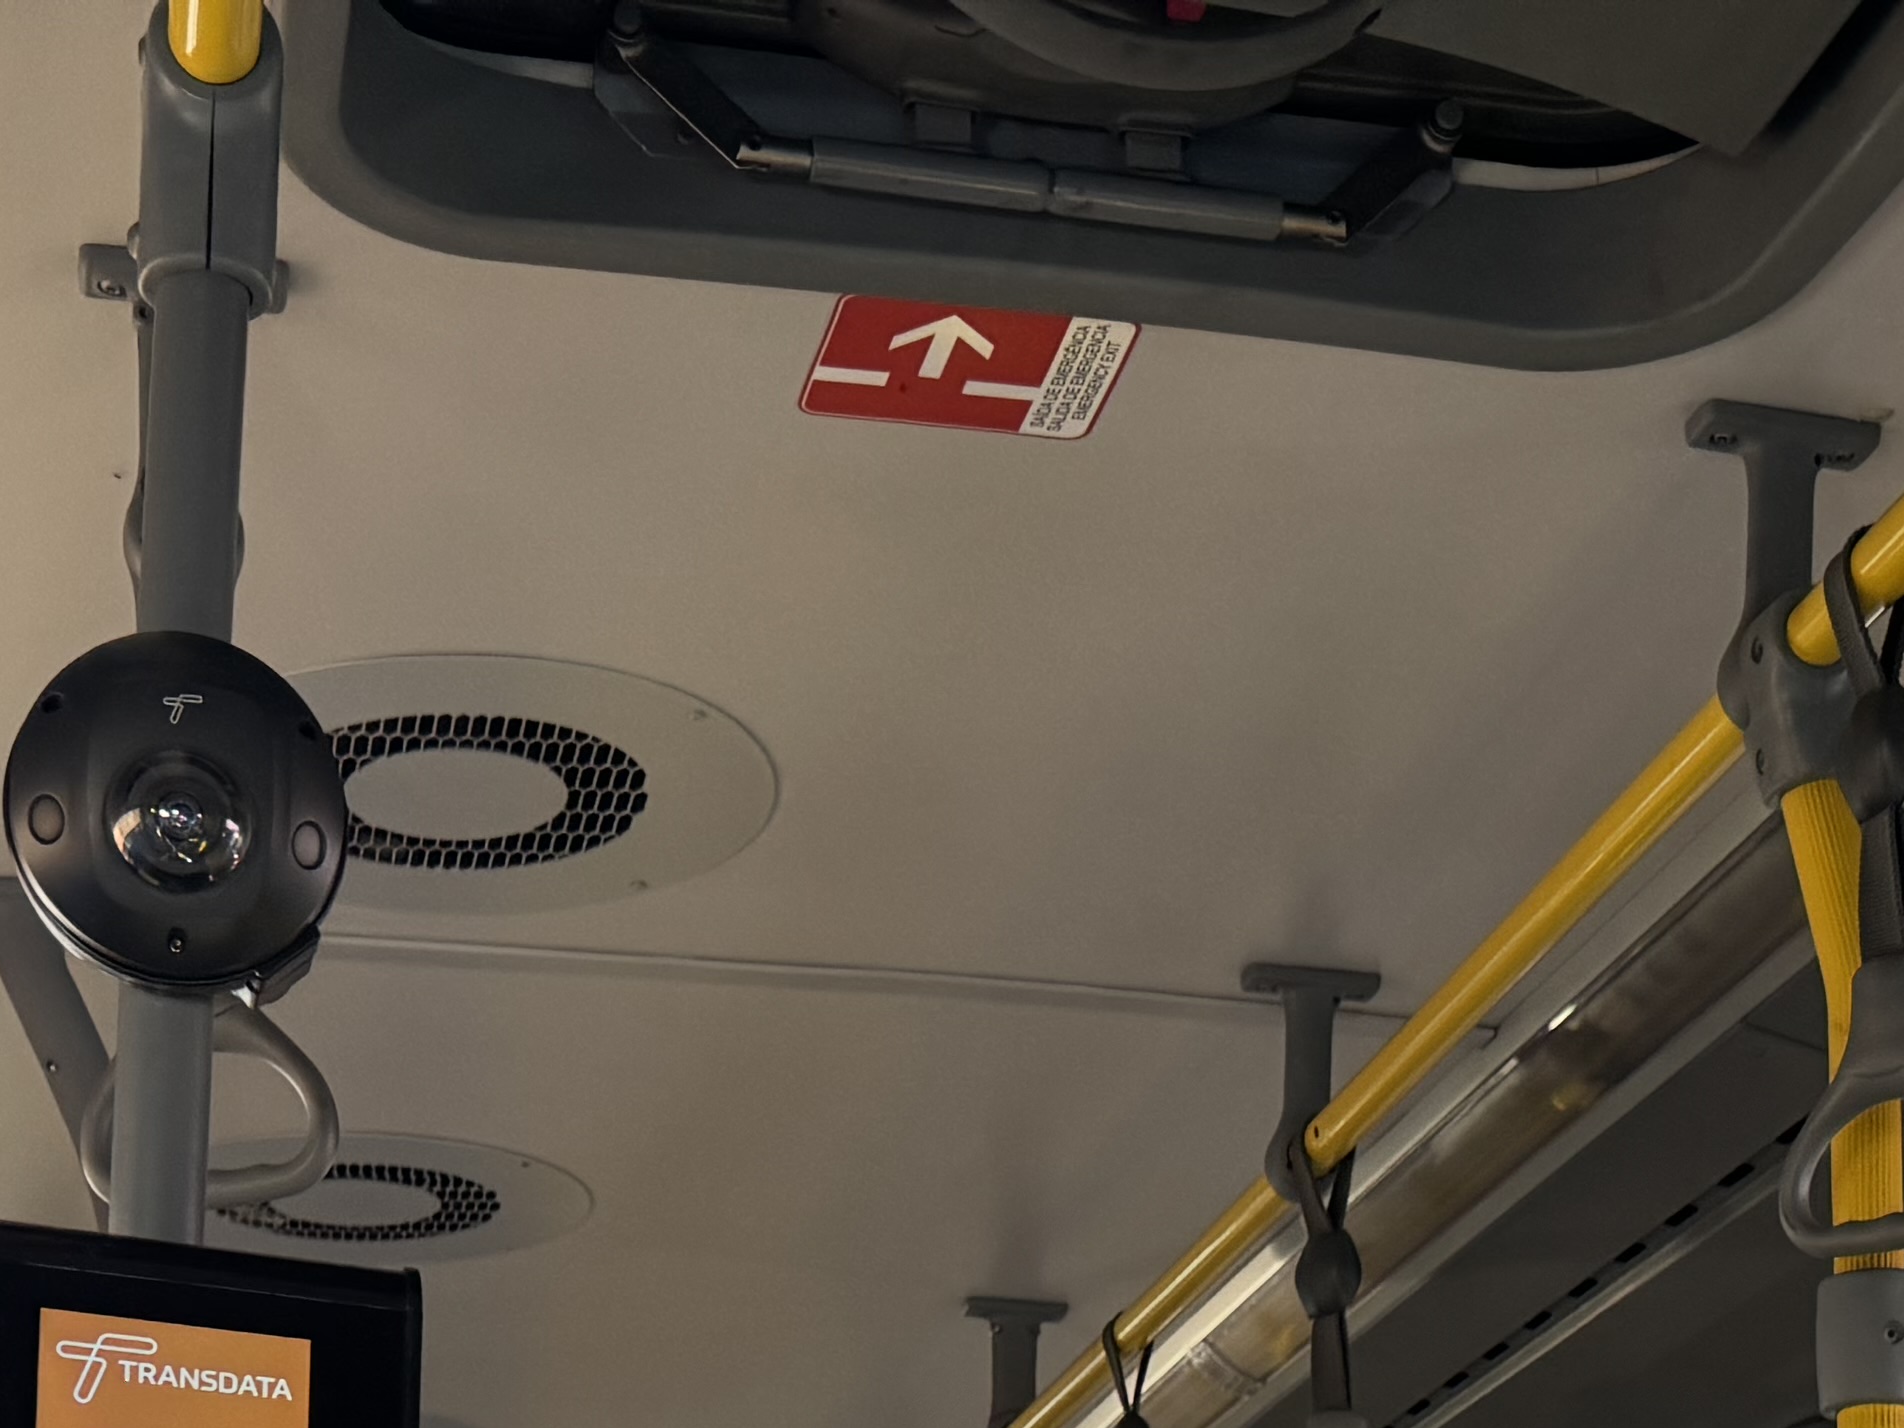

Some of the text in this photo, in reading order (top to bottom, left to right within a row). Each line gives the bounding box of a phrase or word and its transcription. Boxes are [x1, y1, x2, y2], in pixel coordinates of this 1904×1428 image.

[1072, 340, 1121, 420] EMERGENCY EXIT
[118, 1359, 293, 1402] TRANSDATA
